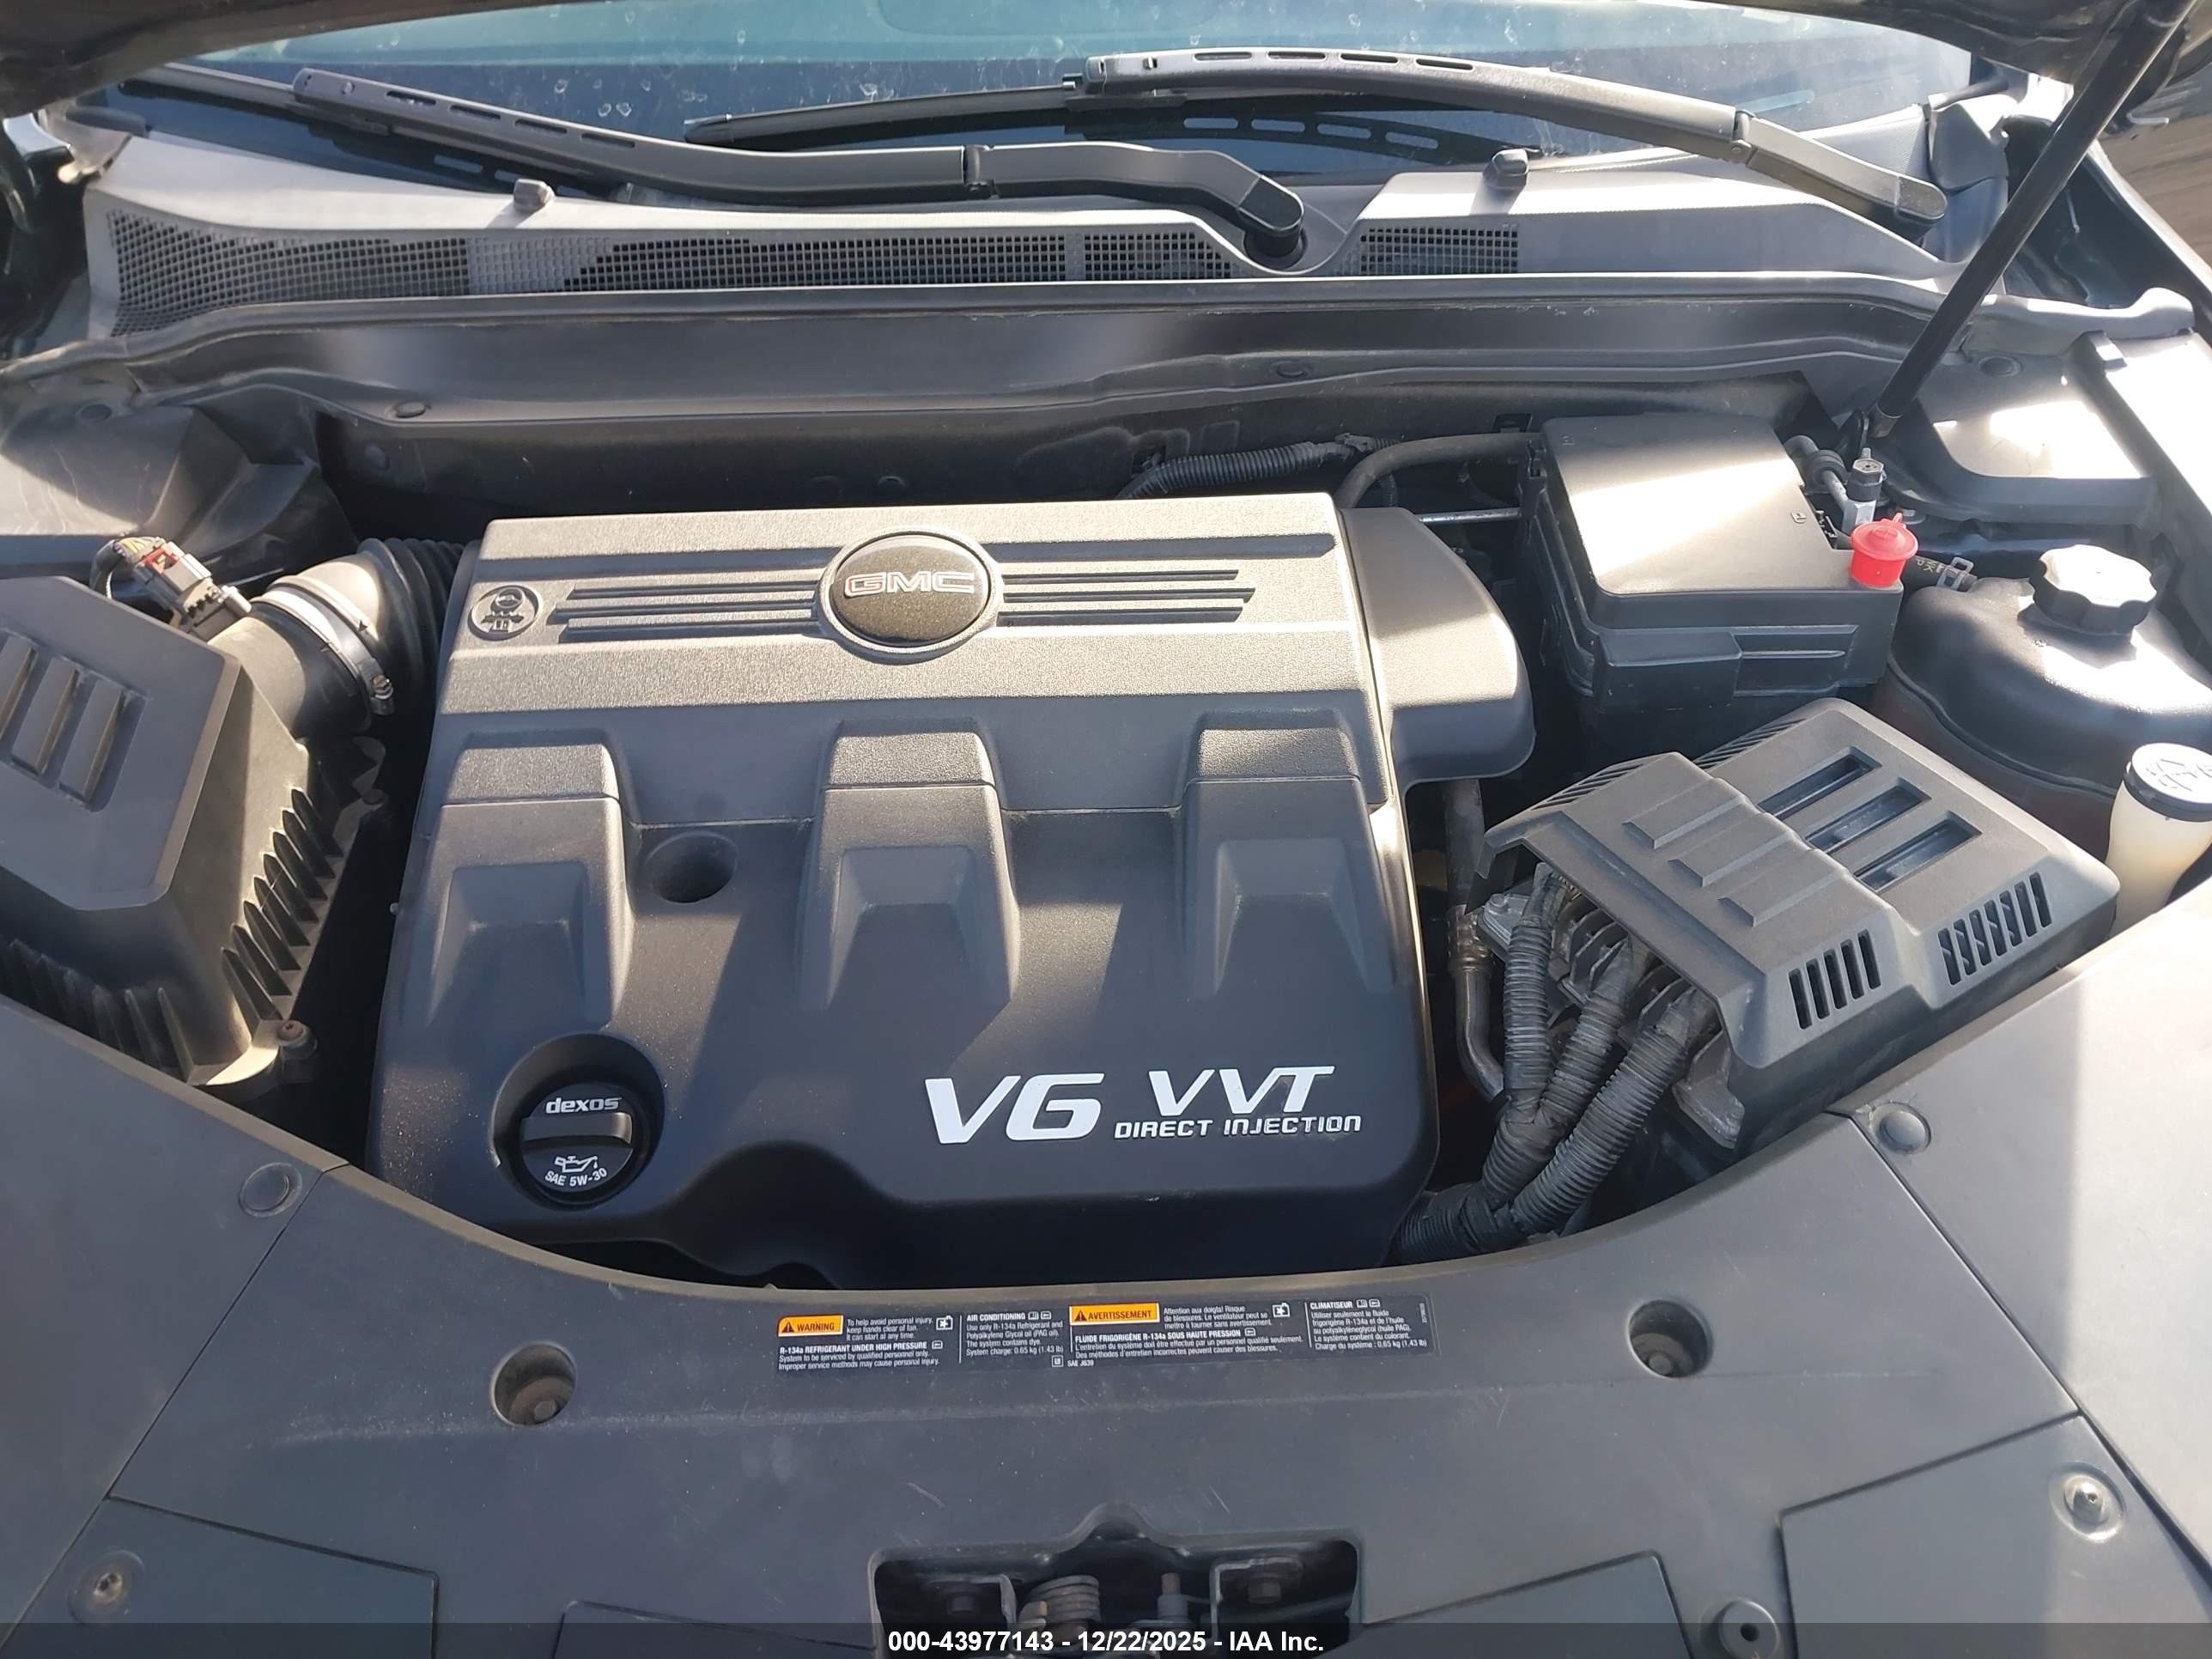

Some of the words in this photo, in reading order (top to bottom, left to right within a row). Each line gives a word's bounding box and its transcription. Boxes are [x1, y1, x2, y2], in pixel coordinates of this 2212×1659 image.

[844, 571, 975, 597] GMC
[546, 1097, 622, 1113] dexos
[925, 1073, 1105, 1144] V6
[1149, 1066, 1335, 1116] VVT
[1115, 1120, 1212, 1139] DIRECT
[1224, 1115, 1361, 1137] INJECTION
[545, 1171, 566, 1186] SAE
[569, 1168, 607, 1187] 5W-30
[1310, 1301, 1353, 1310] CLIMATISEUR
[980, 1312, 1025, 1321] CONDITIONING
[1089, 1310, 1151, 1320] AVERTISSEMENT
[797, 1322, 835, 1332] WARNING
[1099, 1333, 1141, 1342] FRIGORIGÈNE
[1209, 1329, 1241, 1338] PRESSION
[1323, 1334, 1347, 1343] système
[805, 1345, 850, 1353] REFRIGERANT
[852, 1343, 874, 1352] UNDER
[893, 1341, 927, 1350] PRESSURE
[1117, 1341, 1142, 1351] système
[1217, 1338, 1246, 1346] personnel
[1316, 1342, 1336, 1351] Charge
[1348, 1340, 1372, 1350] système
[857, 1352, 883, 1360] qualified
[1030, 1346, 1037, 1355] kg
[1089, 1350, 1118, 1358] méthodes
[1153, 1347, 1187, 1356] incorrectes
[894, 1358, 920, 1367] personal
[921, 1358, 939, 1366] injury.
